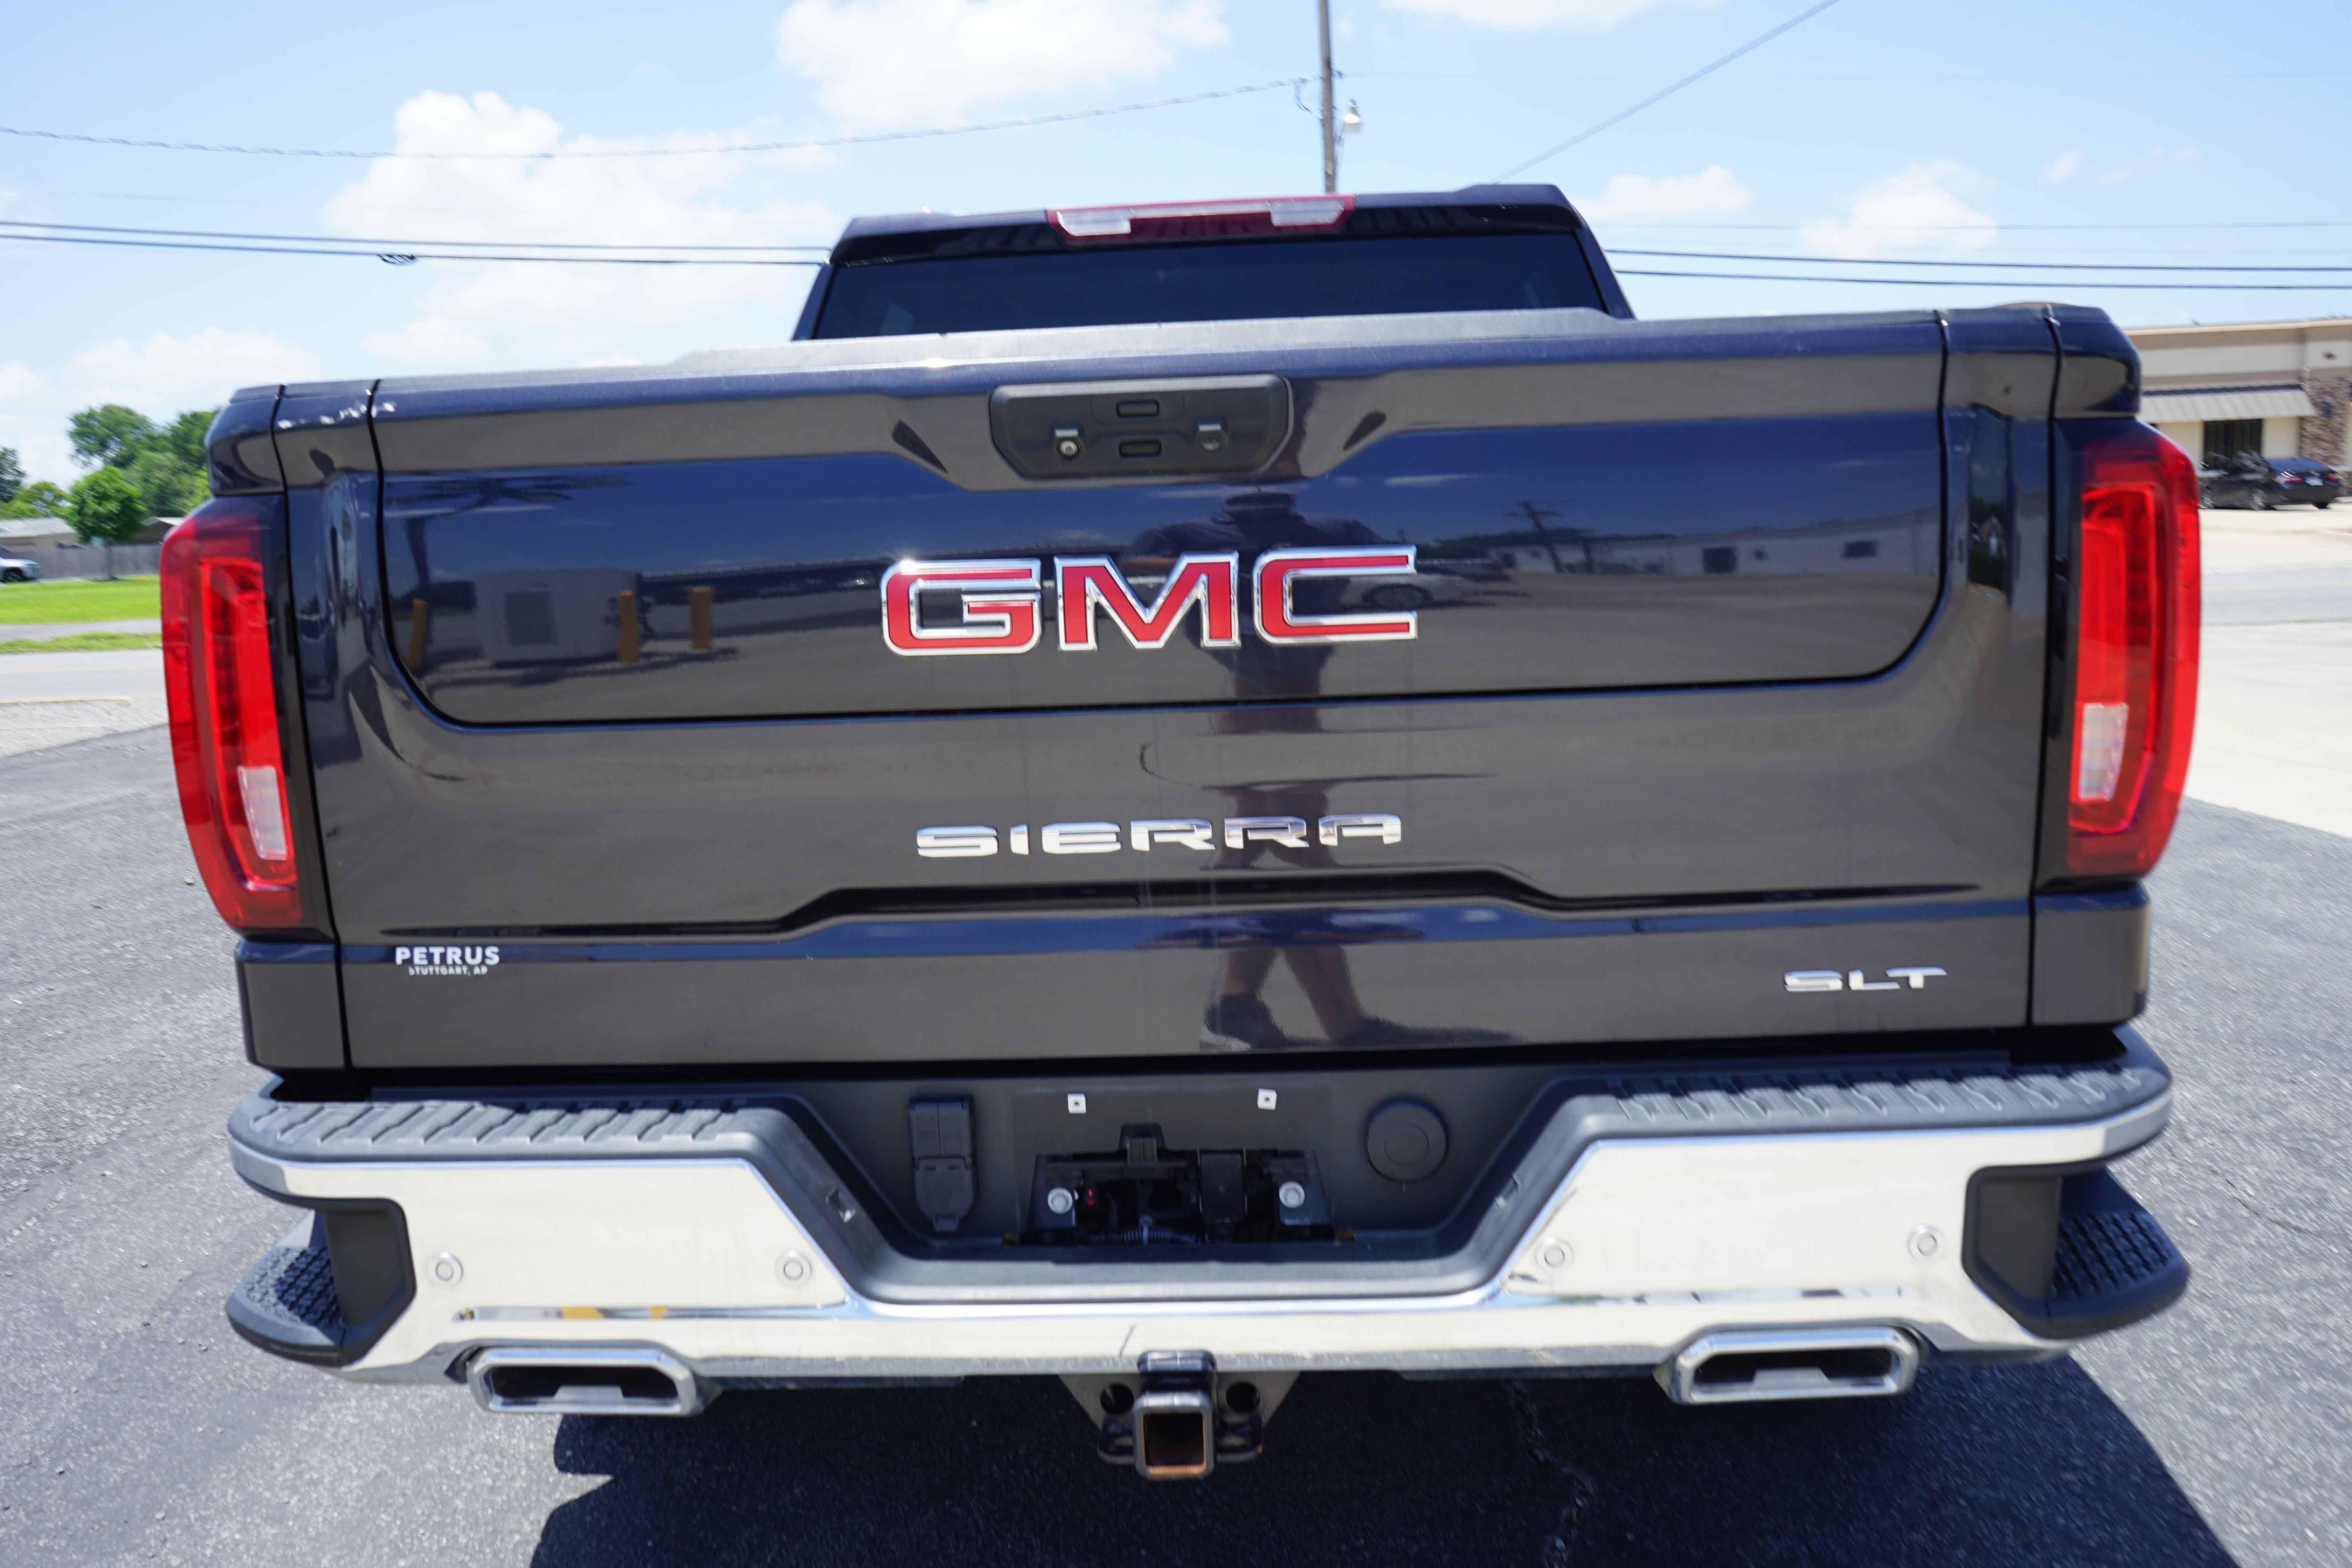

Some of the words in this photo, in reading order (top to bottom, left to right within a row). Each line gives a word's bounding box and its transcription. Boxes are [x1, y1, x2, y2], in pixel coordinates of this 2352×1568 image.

[881, 545, 1418, 656] GMC
[916, 813, 1402, 858] SIERRA
[395, 946, 500, 965] PETRUS
[1784, 966, 1947, 992] SLT
